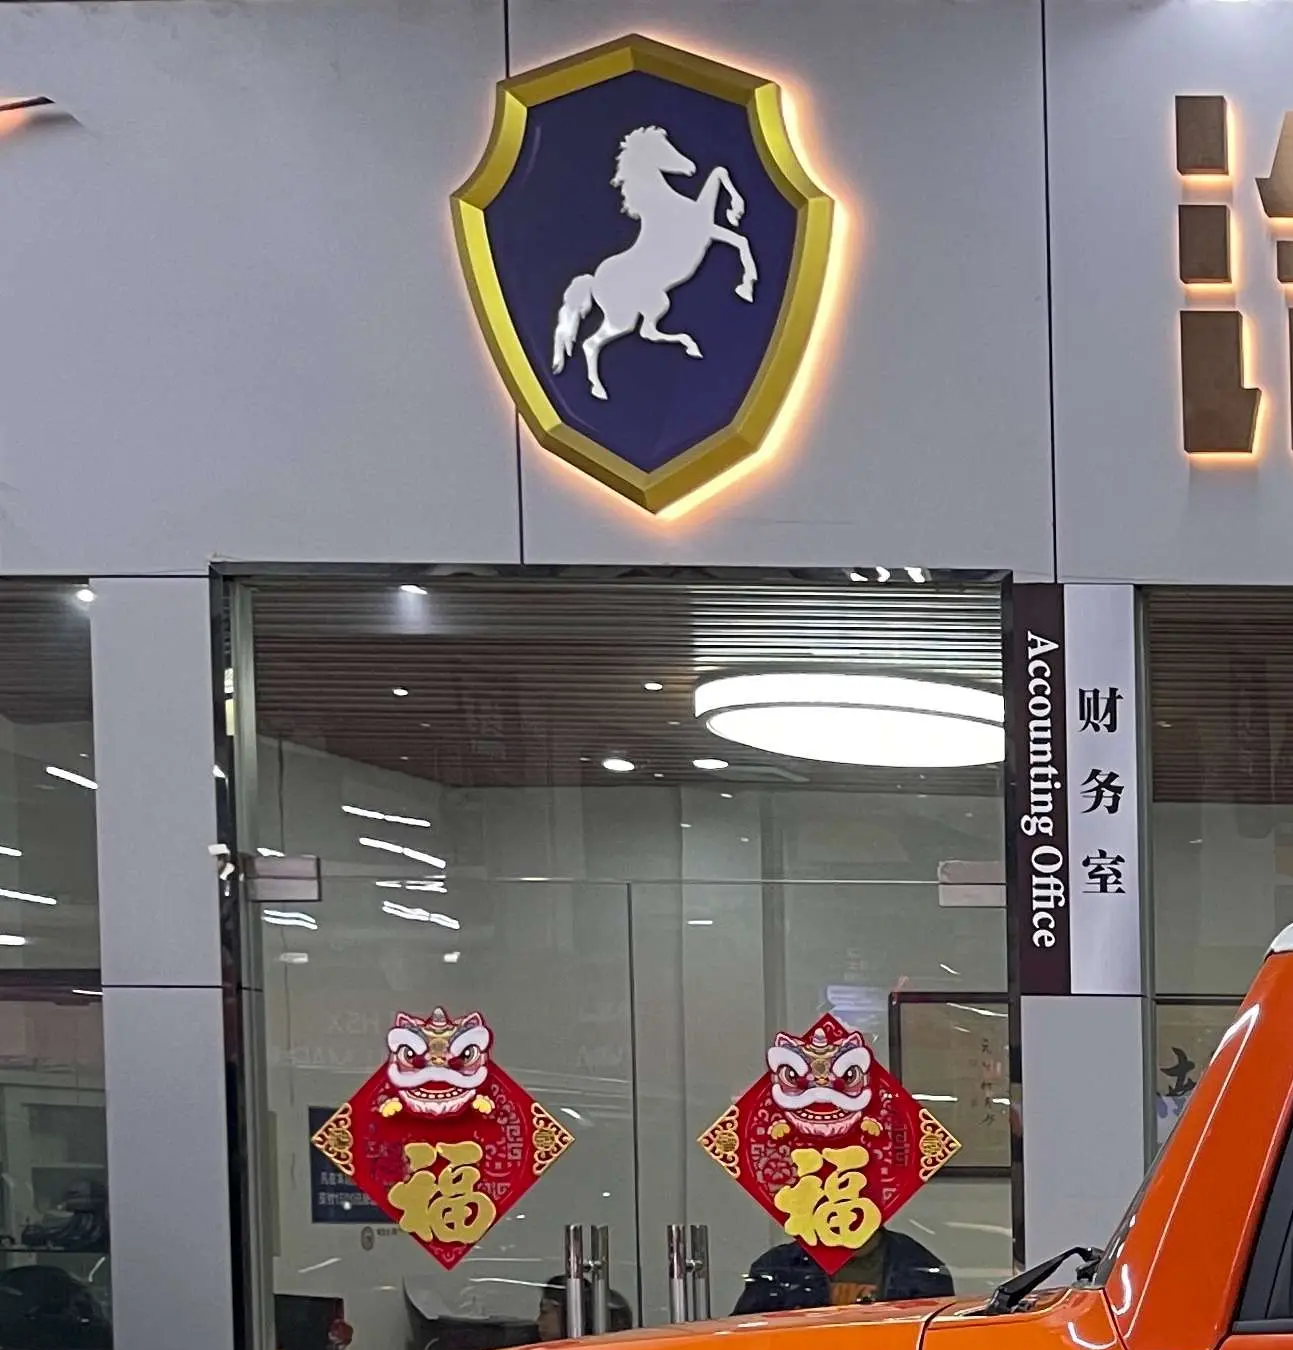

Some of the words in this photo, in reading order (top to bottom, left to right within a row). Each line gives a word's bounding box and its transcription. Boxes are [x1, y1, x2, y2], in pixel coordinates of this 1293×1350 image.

[1020, 630, 1062, 837] Accounting
[1077, 687, 1126, 895] 财务室
[1031, 845, 1065, 948] Office
[387, 1140, 497, 1244] 福
[773, 1145, 882, 1249] 福
